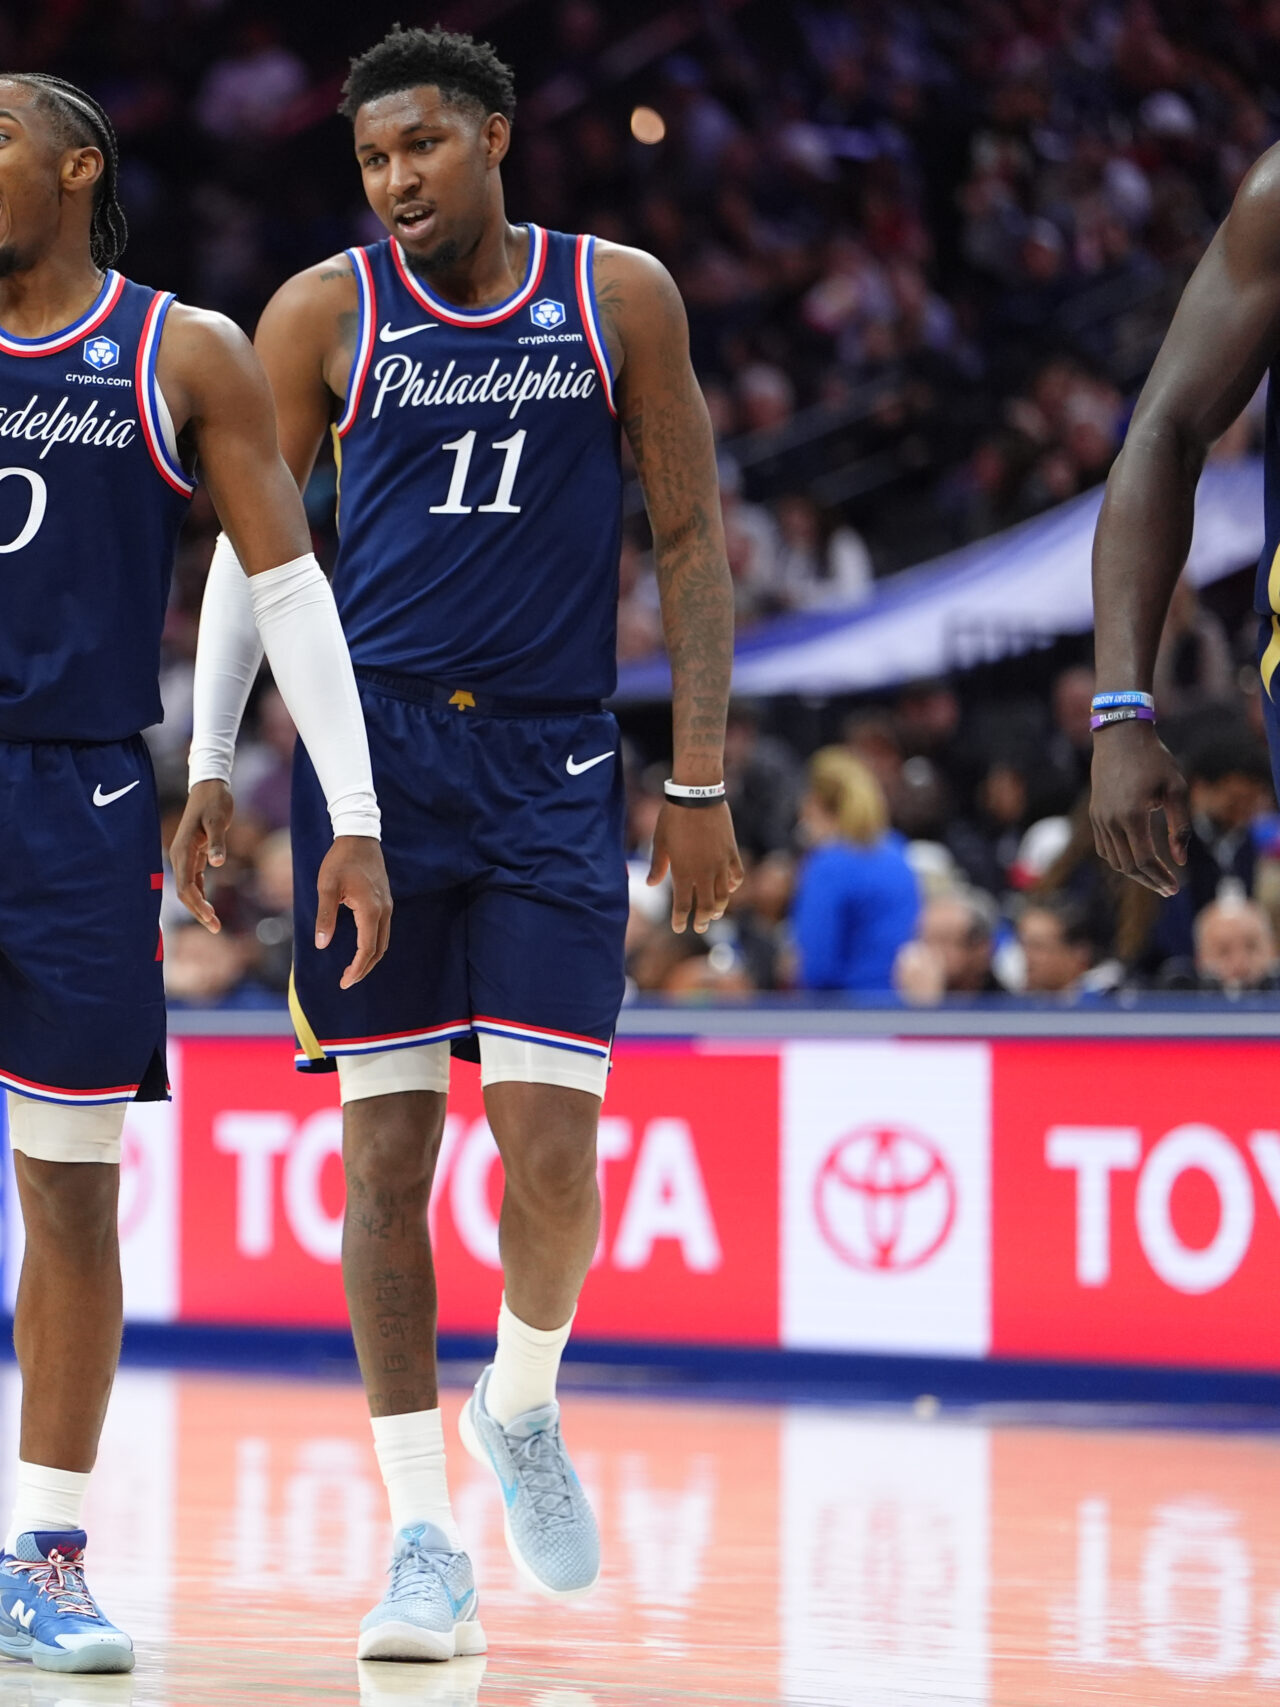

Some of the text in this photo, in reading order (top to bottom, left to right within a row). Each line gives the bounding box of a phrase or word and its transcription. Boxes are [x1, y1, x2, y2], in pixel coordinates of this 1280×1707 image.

[518, 333, 583, 345] crypto.com
[65, 371, 132, 388] crypto.com
[371, 353, 596, 419] Philadelphia
[429, 429, 527, 514] 11
[10, 1599, 36, 1628] N
